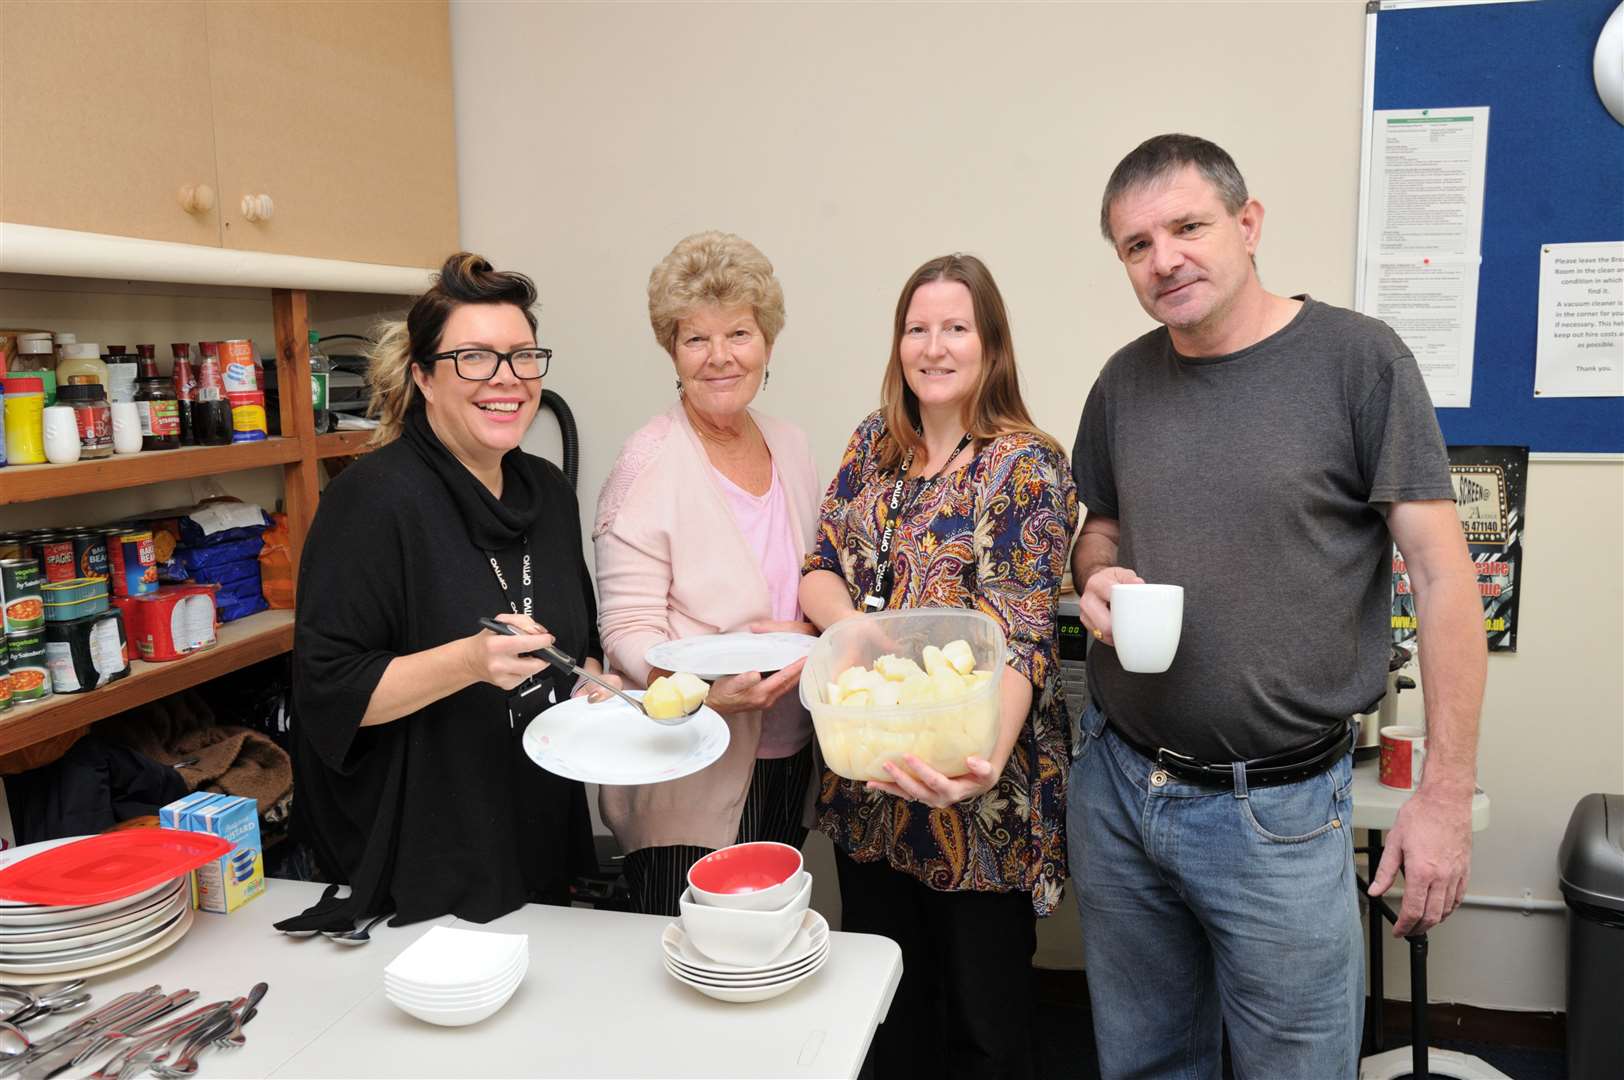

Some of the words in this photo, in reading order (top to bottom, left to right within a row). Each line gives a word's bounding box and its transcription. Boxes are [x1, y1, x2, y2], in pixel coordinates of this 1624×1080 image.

[1555, 257, 1577, 265] Please
[1585, 266, 1596, 274] the
[1561, 277, 1593, 285] condition
[1603, 276, 1623, 284] which
[1588, 286, 1601, 295] find
[1600, 309, 1610, 317] for
[1598, 319, 1612, 327] This
[1554, 331, 1571, 339] keep
[1585, 330, 1598, 338] hire
[890, 480, 904, 509] OPTIVO
[1471, 521, 1498, 532] 471140
[880, 526, 894, 552] OPTIV
[490, 557, 508, 590] OPTIVO
[522, 555, 531, 586] OPTIVO
[1473, 560, 1510, 576] eatre
[523, 596, 532, 617] TIVO
[1485, 618, 1506, 632] o.uk
[224, 821, 257, 842] USTARD
